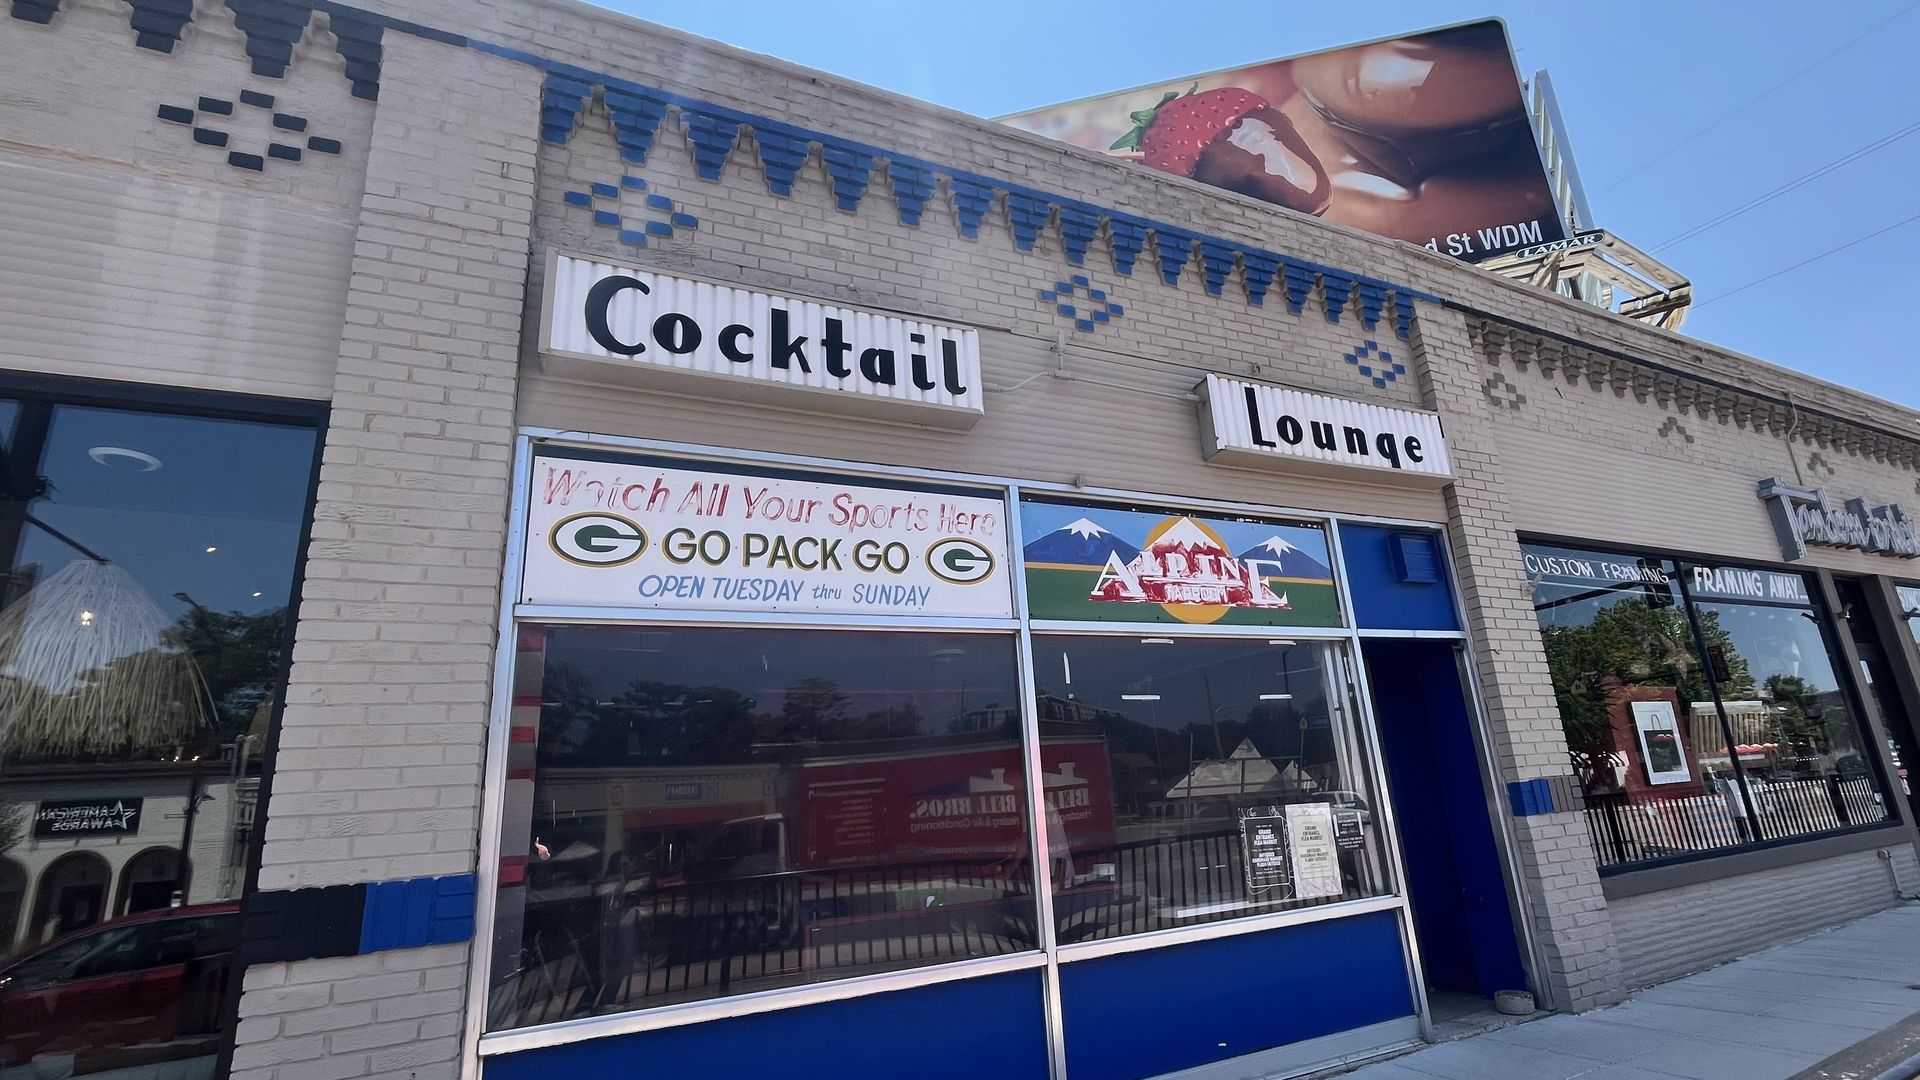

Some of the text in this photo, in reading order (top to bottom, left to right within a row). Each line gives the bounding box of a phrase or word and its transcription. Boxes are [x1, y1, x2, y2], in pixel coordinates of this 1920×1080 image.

[1446, 233, 1473, 256] St
[1478, 220, 1543, 250] WDM
[1524, 235, 1596, 257] LAMAR
[585, 275, 966, 395] Cocktail
[542, 466, 998, 535] Watch All Your Sports Here
[661, 527, 911, 574] GO PACK GO
[1525, 554, 1669, 583] CUSTOM FRAMING
[637, 574, 931, 607] OPEN TUESDAY thru SUNDAY
[1090, 549, 1289, 605] ALPINE
[1693, 567, 1763, 596] FRAMING
